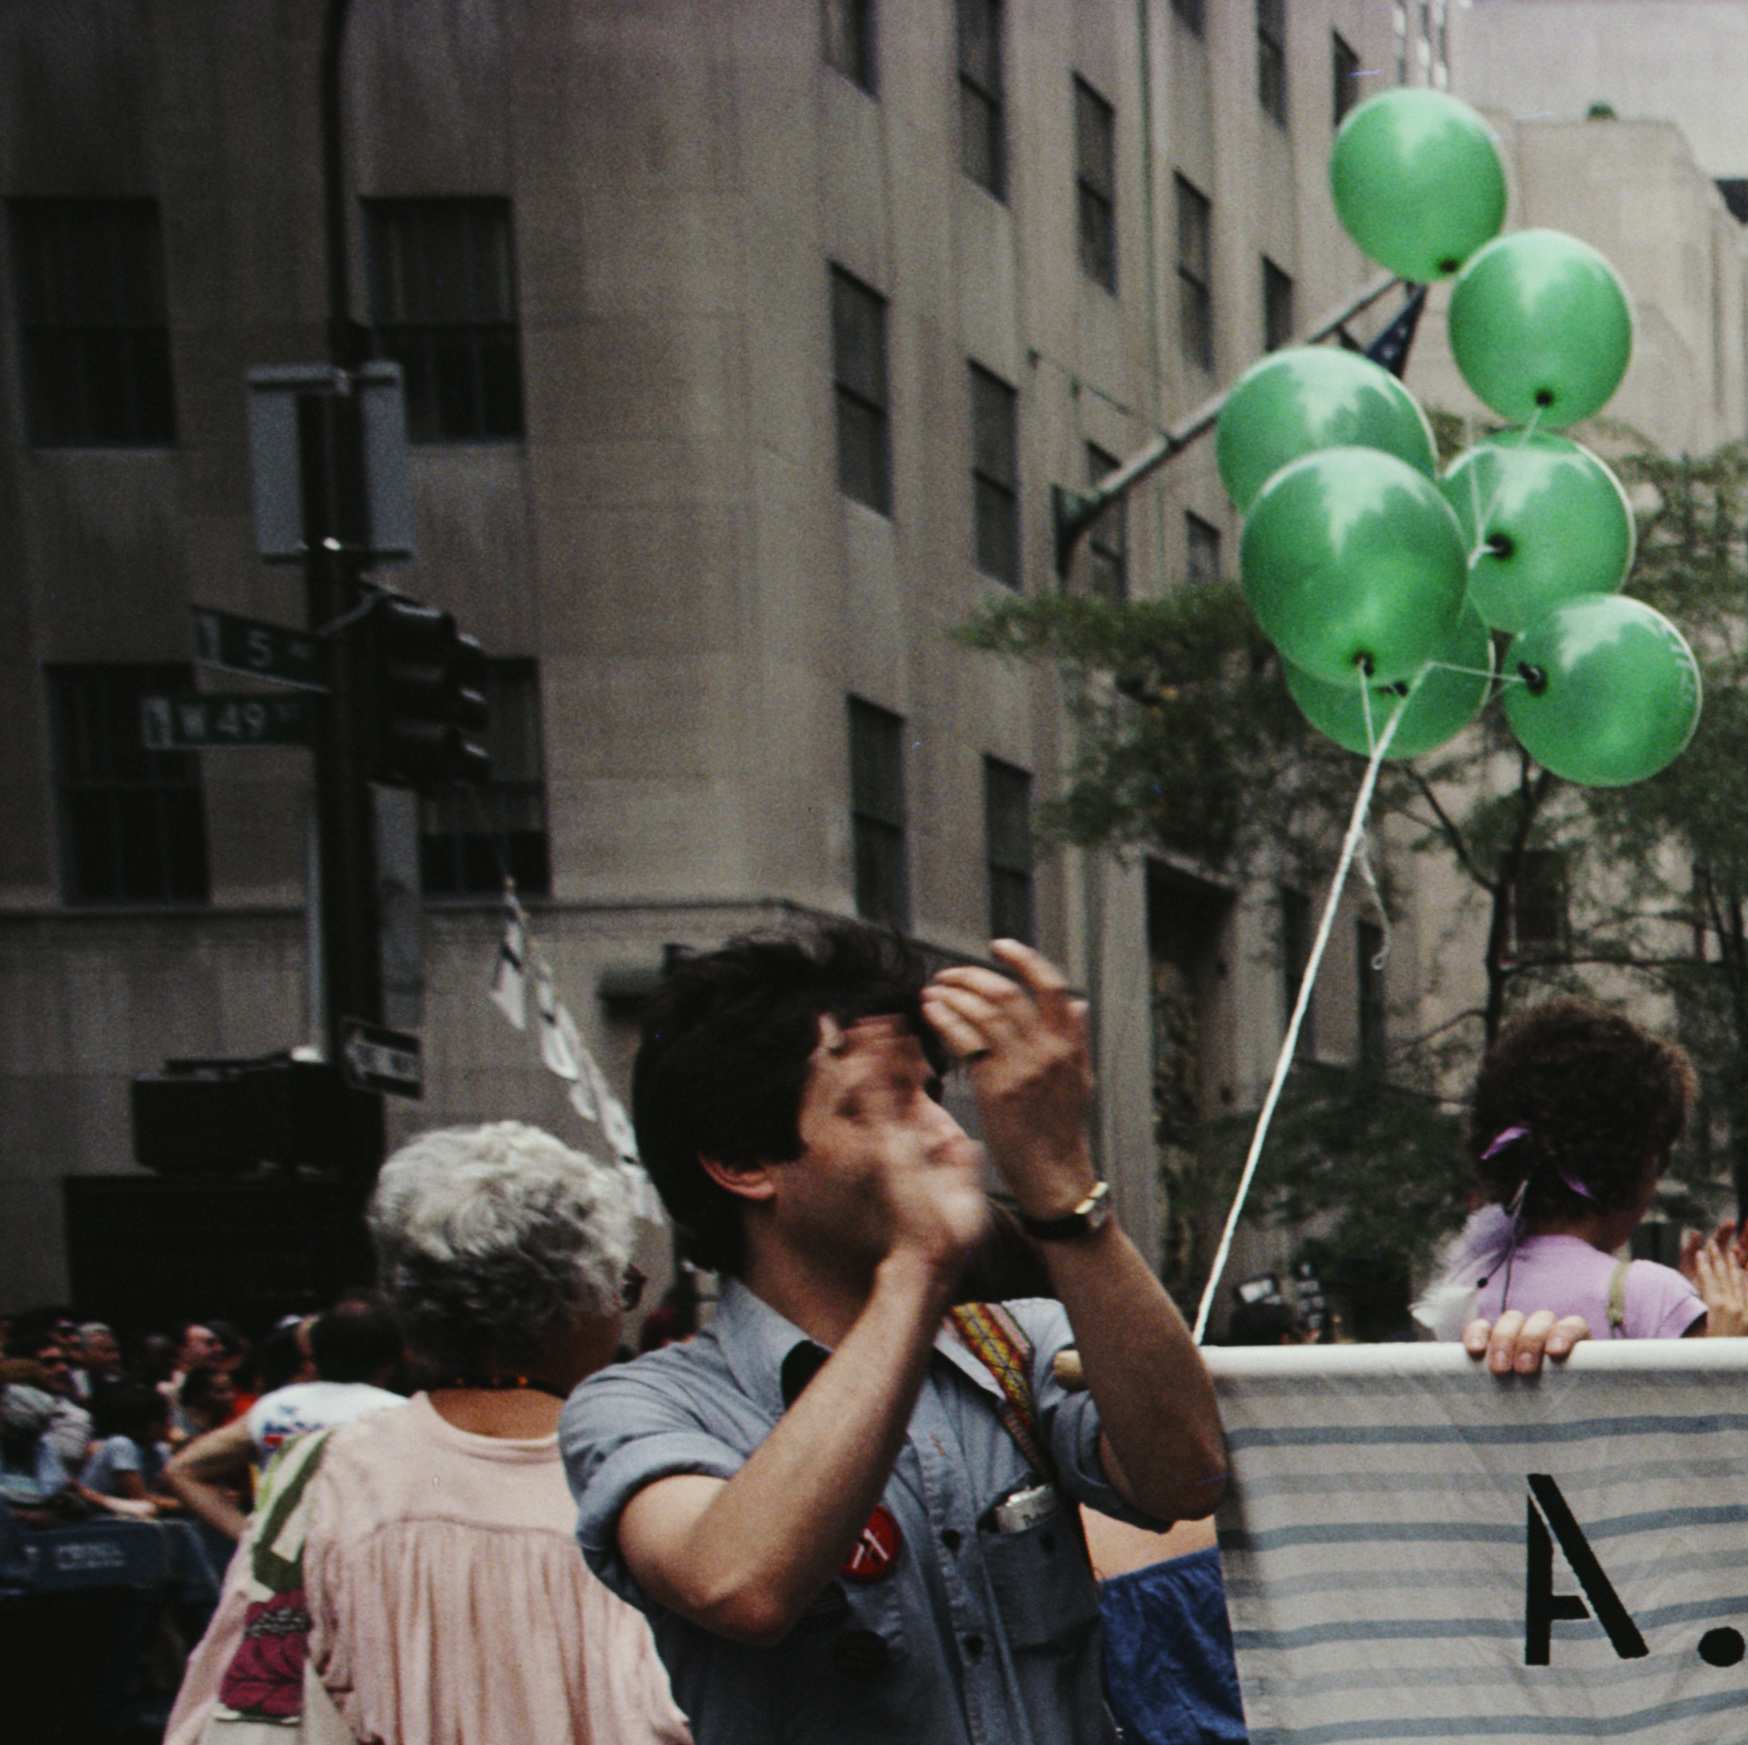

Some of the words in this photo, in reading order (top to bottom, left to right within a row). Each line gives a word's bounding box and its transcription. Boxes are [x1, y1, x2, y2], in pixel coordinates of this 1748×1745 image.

[247, 629, 273, 668] 5
[179, 702, 207, 738] W
[216, 702, 265, 736] 49
